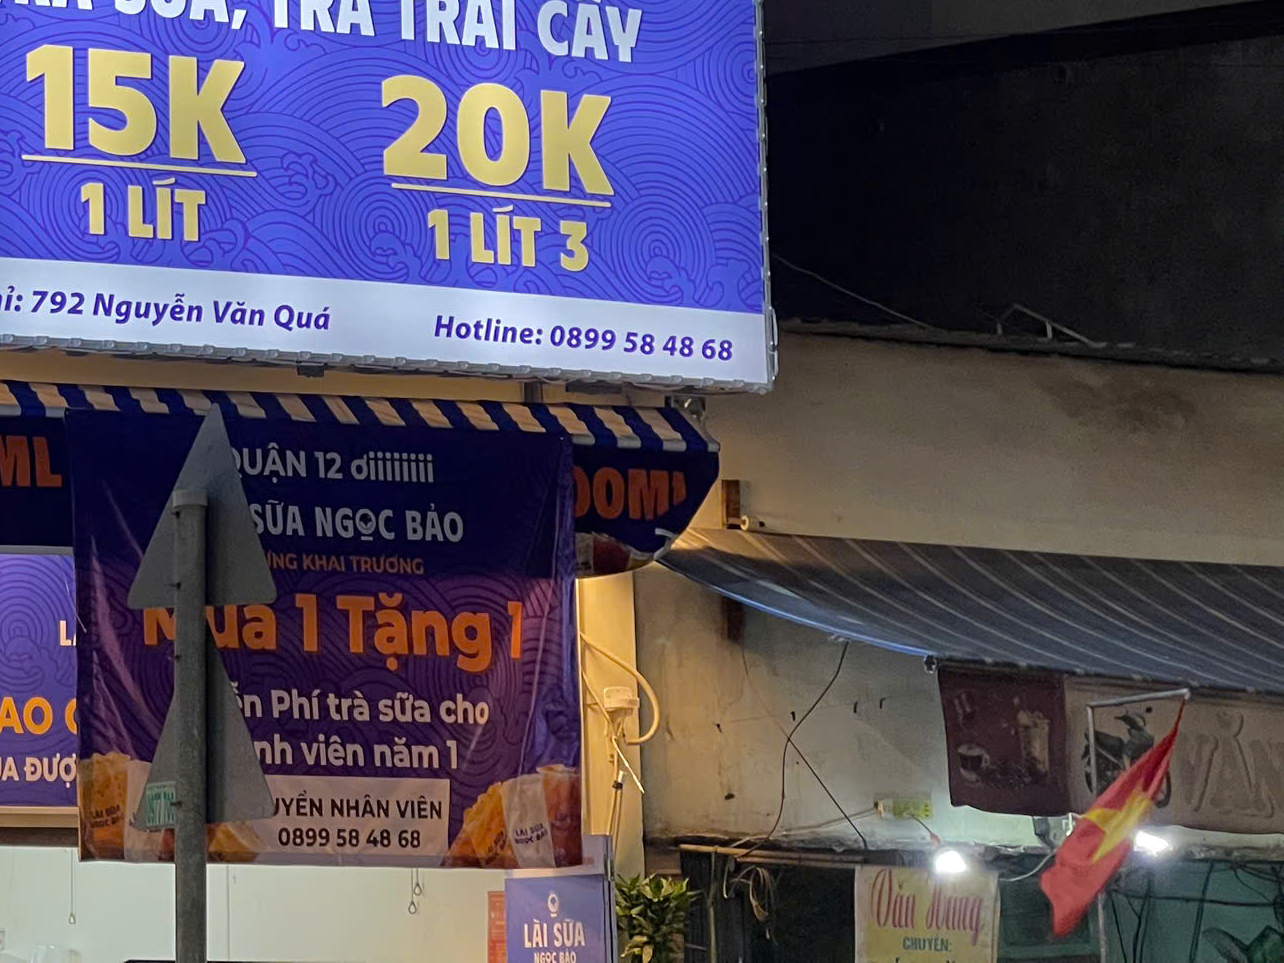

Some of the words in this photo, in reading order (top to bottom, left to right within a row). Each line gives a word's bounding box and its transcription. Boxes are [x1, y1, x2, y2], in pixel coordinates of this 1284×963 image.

[26, 44, 246, 163] 15K
[380, 74, 615, 196] 20K
[80, 183, 104, 235] 1
[127, 177, 206, 242] LÍT
[427, 209, 449, 259] 1
[469, 205, 541, 267] LÍT
[560, 221, 589, 271] 3
[31, 289, 84, 315] 792
[93, 293, 203, 327] Nguyễn
[212, 301, 265, 327] Văn
[274, 304, 332, 331] Quá
[434, 315, 543, 345] Hotline:
[550, 324, 616, 350] 0899
[623, 331, 655, 356] 58
[663, 335, 694, 357] 48
[700, 338, 733, 361] 68
[314, 450, 343, 479] 12
[315, 507, 395, 541] NGỌC
[405, 503, 464, 542] BẢO
[302, 553, 345, 572] KHAI
[349, 553, 424, 575] TRƯƠNG
[295, 593, 319, 652] 1
[336, 592, 492, 673] Tặng
[508, 601, 524, 659] 1
[271, 687, 321, 721] Phí
[327, 690, 370, 722] trà
[379, 692, 431, 726] sữa
[440, 693, 490, 726] cho
[300, 735, 365, 768] viên
[373, 737, 439, 769] năm
[446, 740, 458, 769] 1
[330, 794, 389, 819] NHÂN
[396, 795, 442, 819] VIÊN
[278, 827, 330, 847] 0899
[336, 828, 360, 848] 58
[366, 829, 391, 848] 48
[398, 830, 421, 849] 68
[523, 918, 548, 948] LÀI
[553, 918, 586, 948] SỮA
